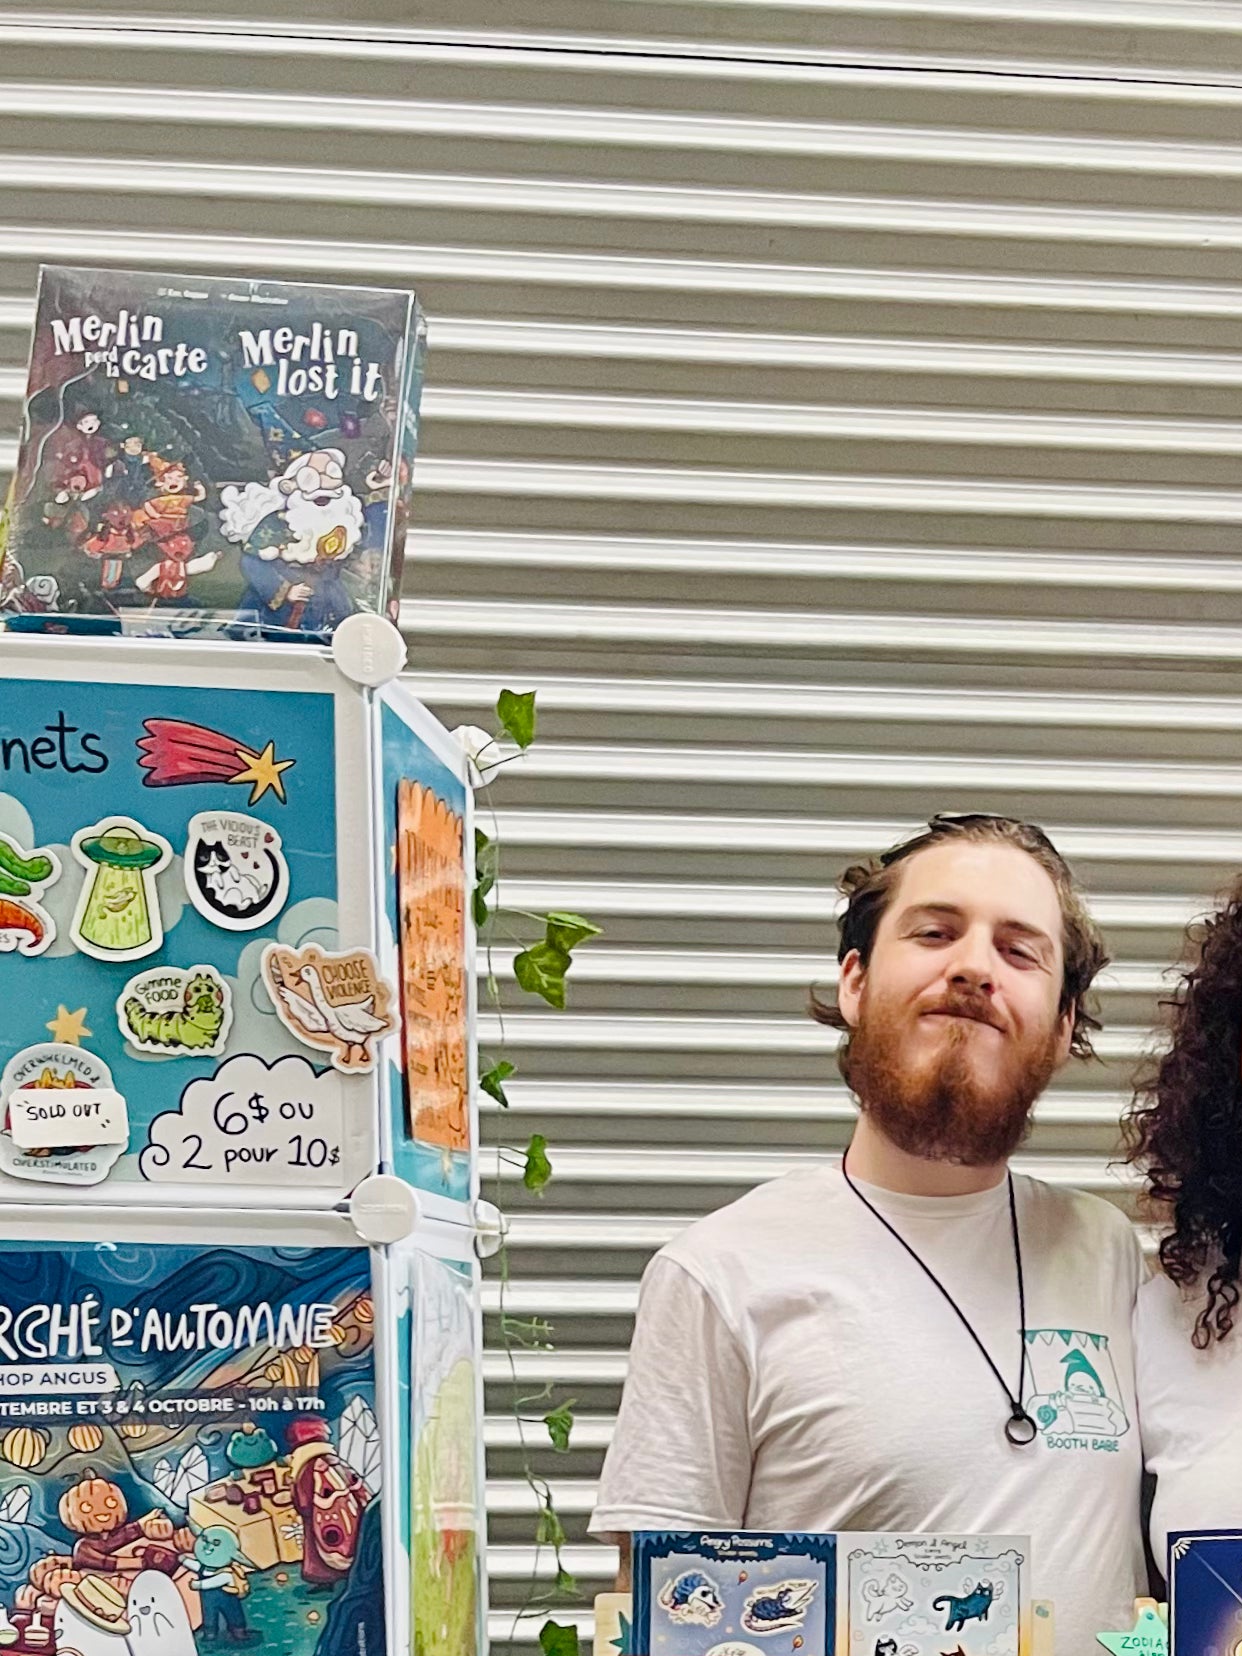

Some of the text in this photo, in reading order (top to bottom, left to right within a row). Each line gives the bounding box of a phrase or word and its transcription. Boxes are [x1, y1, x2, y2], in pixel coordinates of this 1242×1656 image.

[51, 310, 163, 355] Merlin
[239, 322, 358, 368] Merlin
[85, 345, 117, 367] perd
[122, 344, 207, 380] carte
[278, 357, 381, 401] lost it
[0, 710, 109, 775] nets
[226, 833, 258, 848] BEAST
[321, 959, 367, 982] CHOOSE
[135, 976, 182, 994] Gimme
[327, 980, 372, 999] VIOLENCE
[144, 989, 179, 1005] FOOD
[26, 1103, 101, 1121] SOLD OUT
[279, 1101, 314, 1121] ou
[182, 1135, 340, 1172] 2 pour 10$
[39, 1371, 107, 1386] ANGUS
[77, 1400, 98, 1415] ET
[102, 1400, 114, 1414] 3
[116, 1400, 130, 1414] &
[131, 1400, 145, 1414] 4
[149, 1398, 234, 1414] OCTOBRE
[250, 1397, 276, 1413] 10h
[281, 1397, 293, 1412] à
[296, 1397, 326, 1411] 17h
[1047, 1436, 1088, 1450] BOOTH
